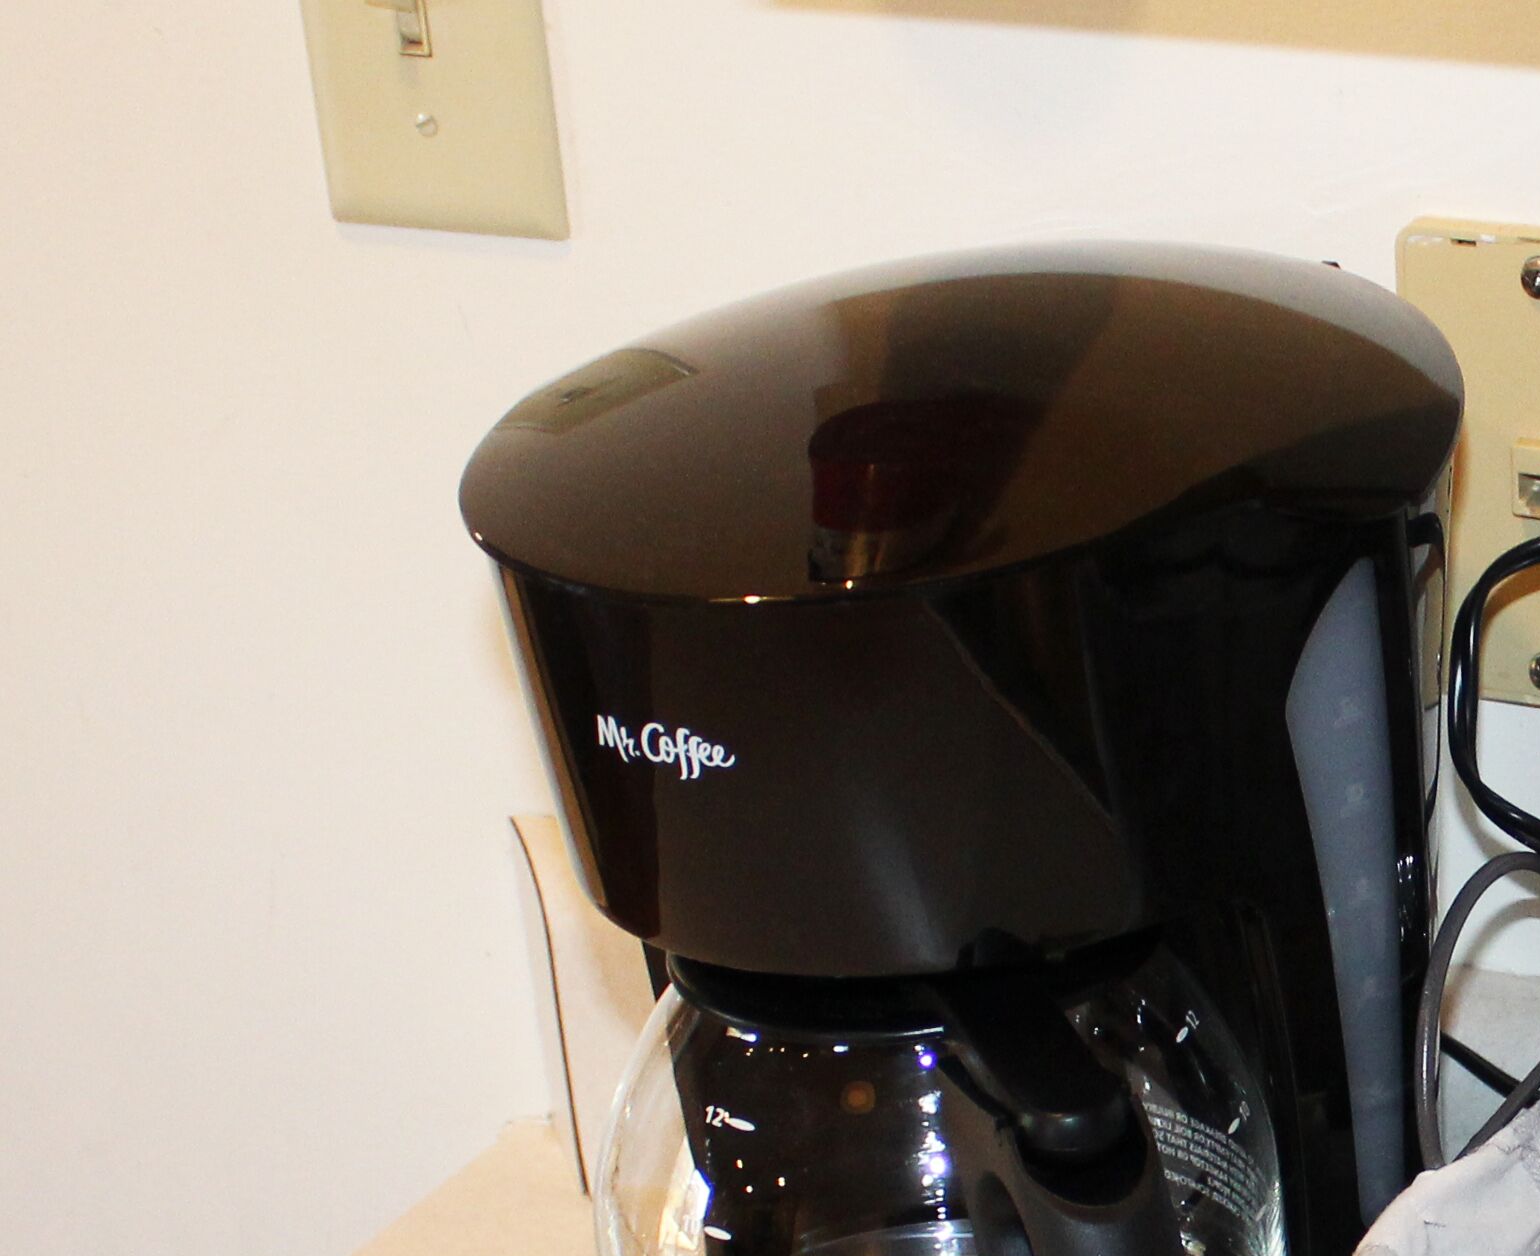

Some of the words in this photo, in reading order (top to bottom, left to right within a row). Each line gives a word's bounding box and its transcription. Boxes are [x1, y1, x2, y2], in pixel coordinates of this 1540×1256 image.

[597, 714, 640, 763] Mr.
[640, 722, 736, 781] Coffee
[705, 1105, 725, 1128] 12
